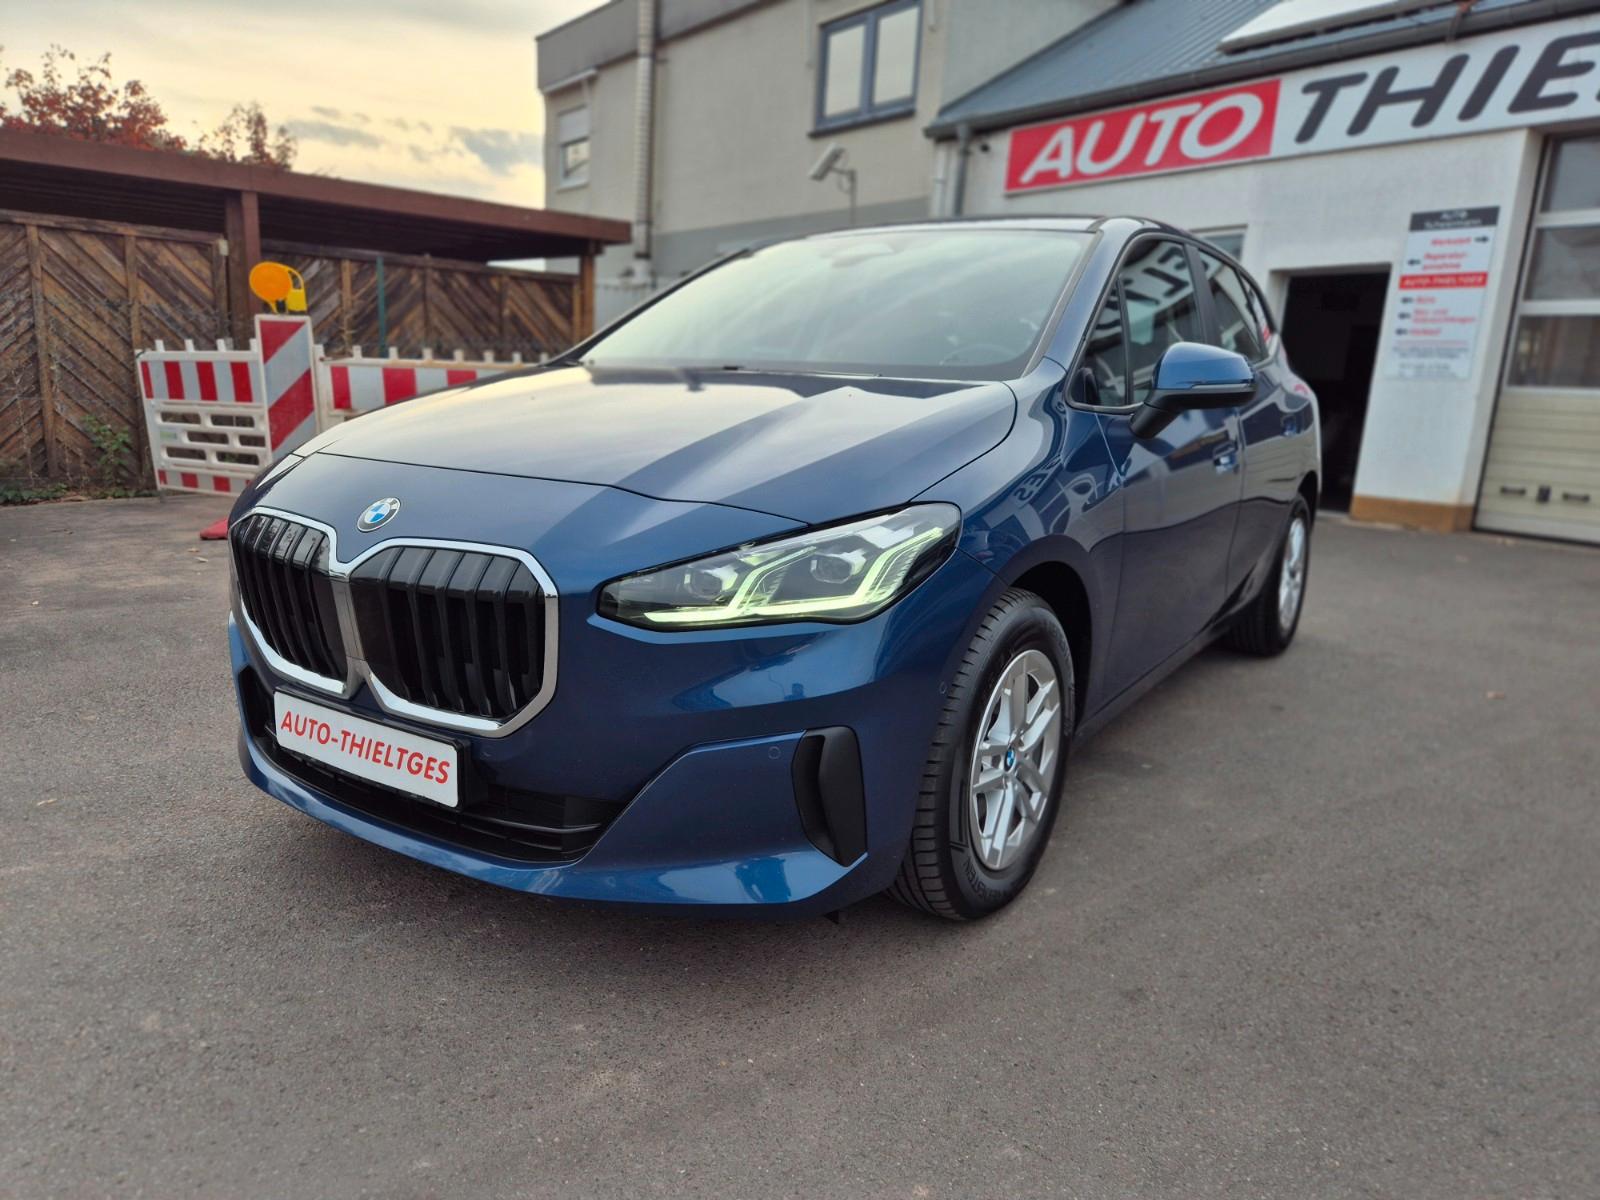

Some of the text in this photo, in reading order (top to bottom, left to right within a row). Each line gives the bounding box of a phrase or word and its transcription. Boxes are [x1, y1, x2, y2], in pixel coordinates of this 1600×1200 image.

[1020, 31, 1600, 184] AUTO THIE
[281, 711, 450, 784] AUTO-THIELTGES
